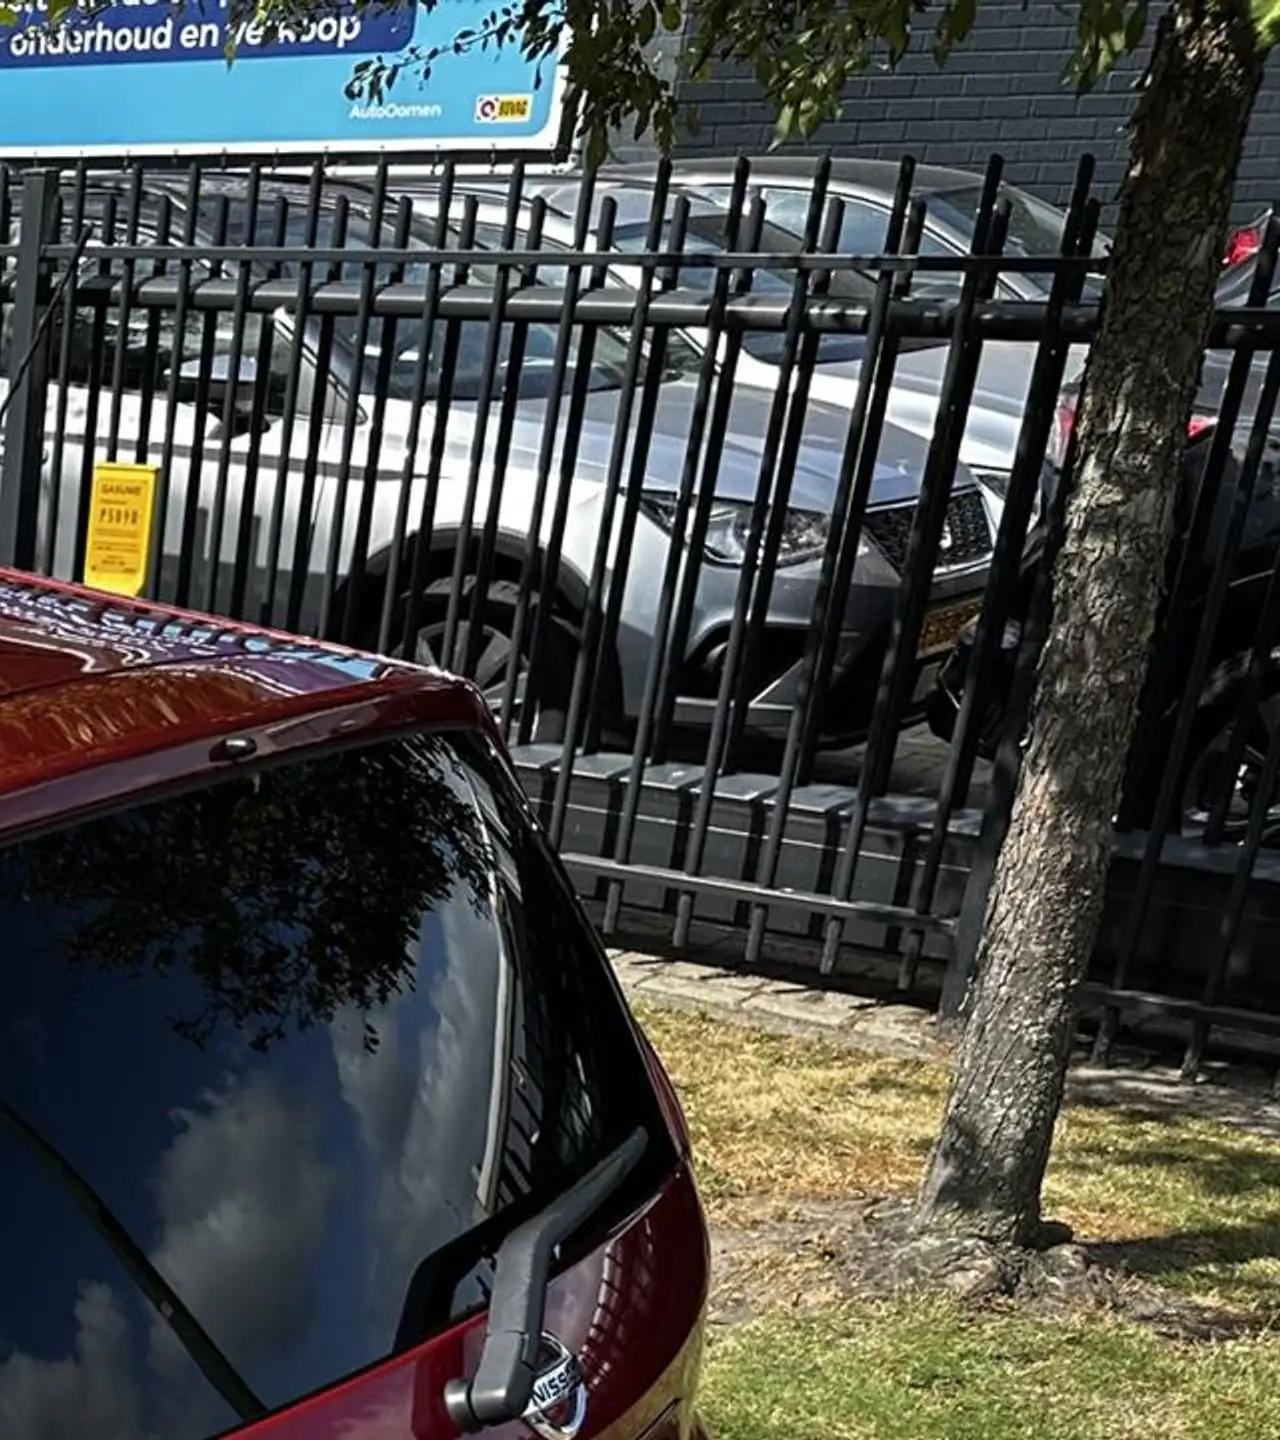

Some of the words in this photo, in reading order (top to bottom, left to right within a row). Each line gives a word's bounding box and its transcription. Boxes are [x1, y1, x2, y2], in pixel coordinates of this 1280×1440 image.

[10, 18, 173, 57] onderhoud
[180, 22, 220, 49] en
[225, 14, 361, 49] vekoop
[348, 103, 441, 119] AutoOomen
